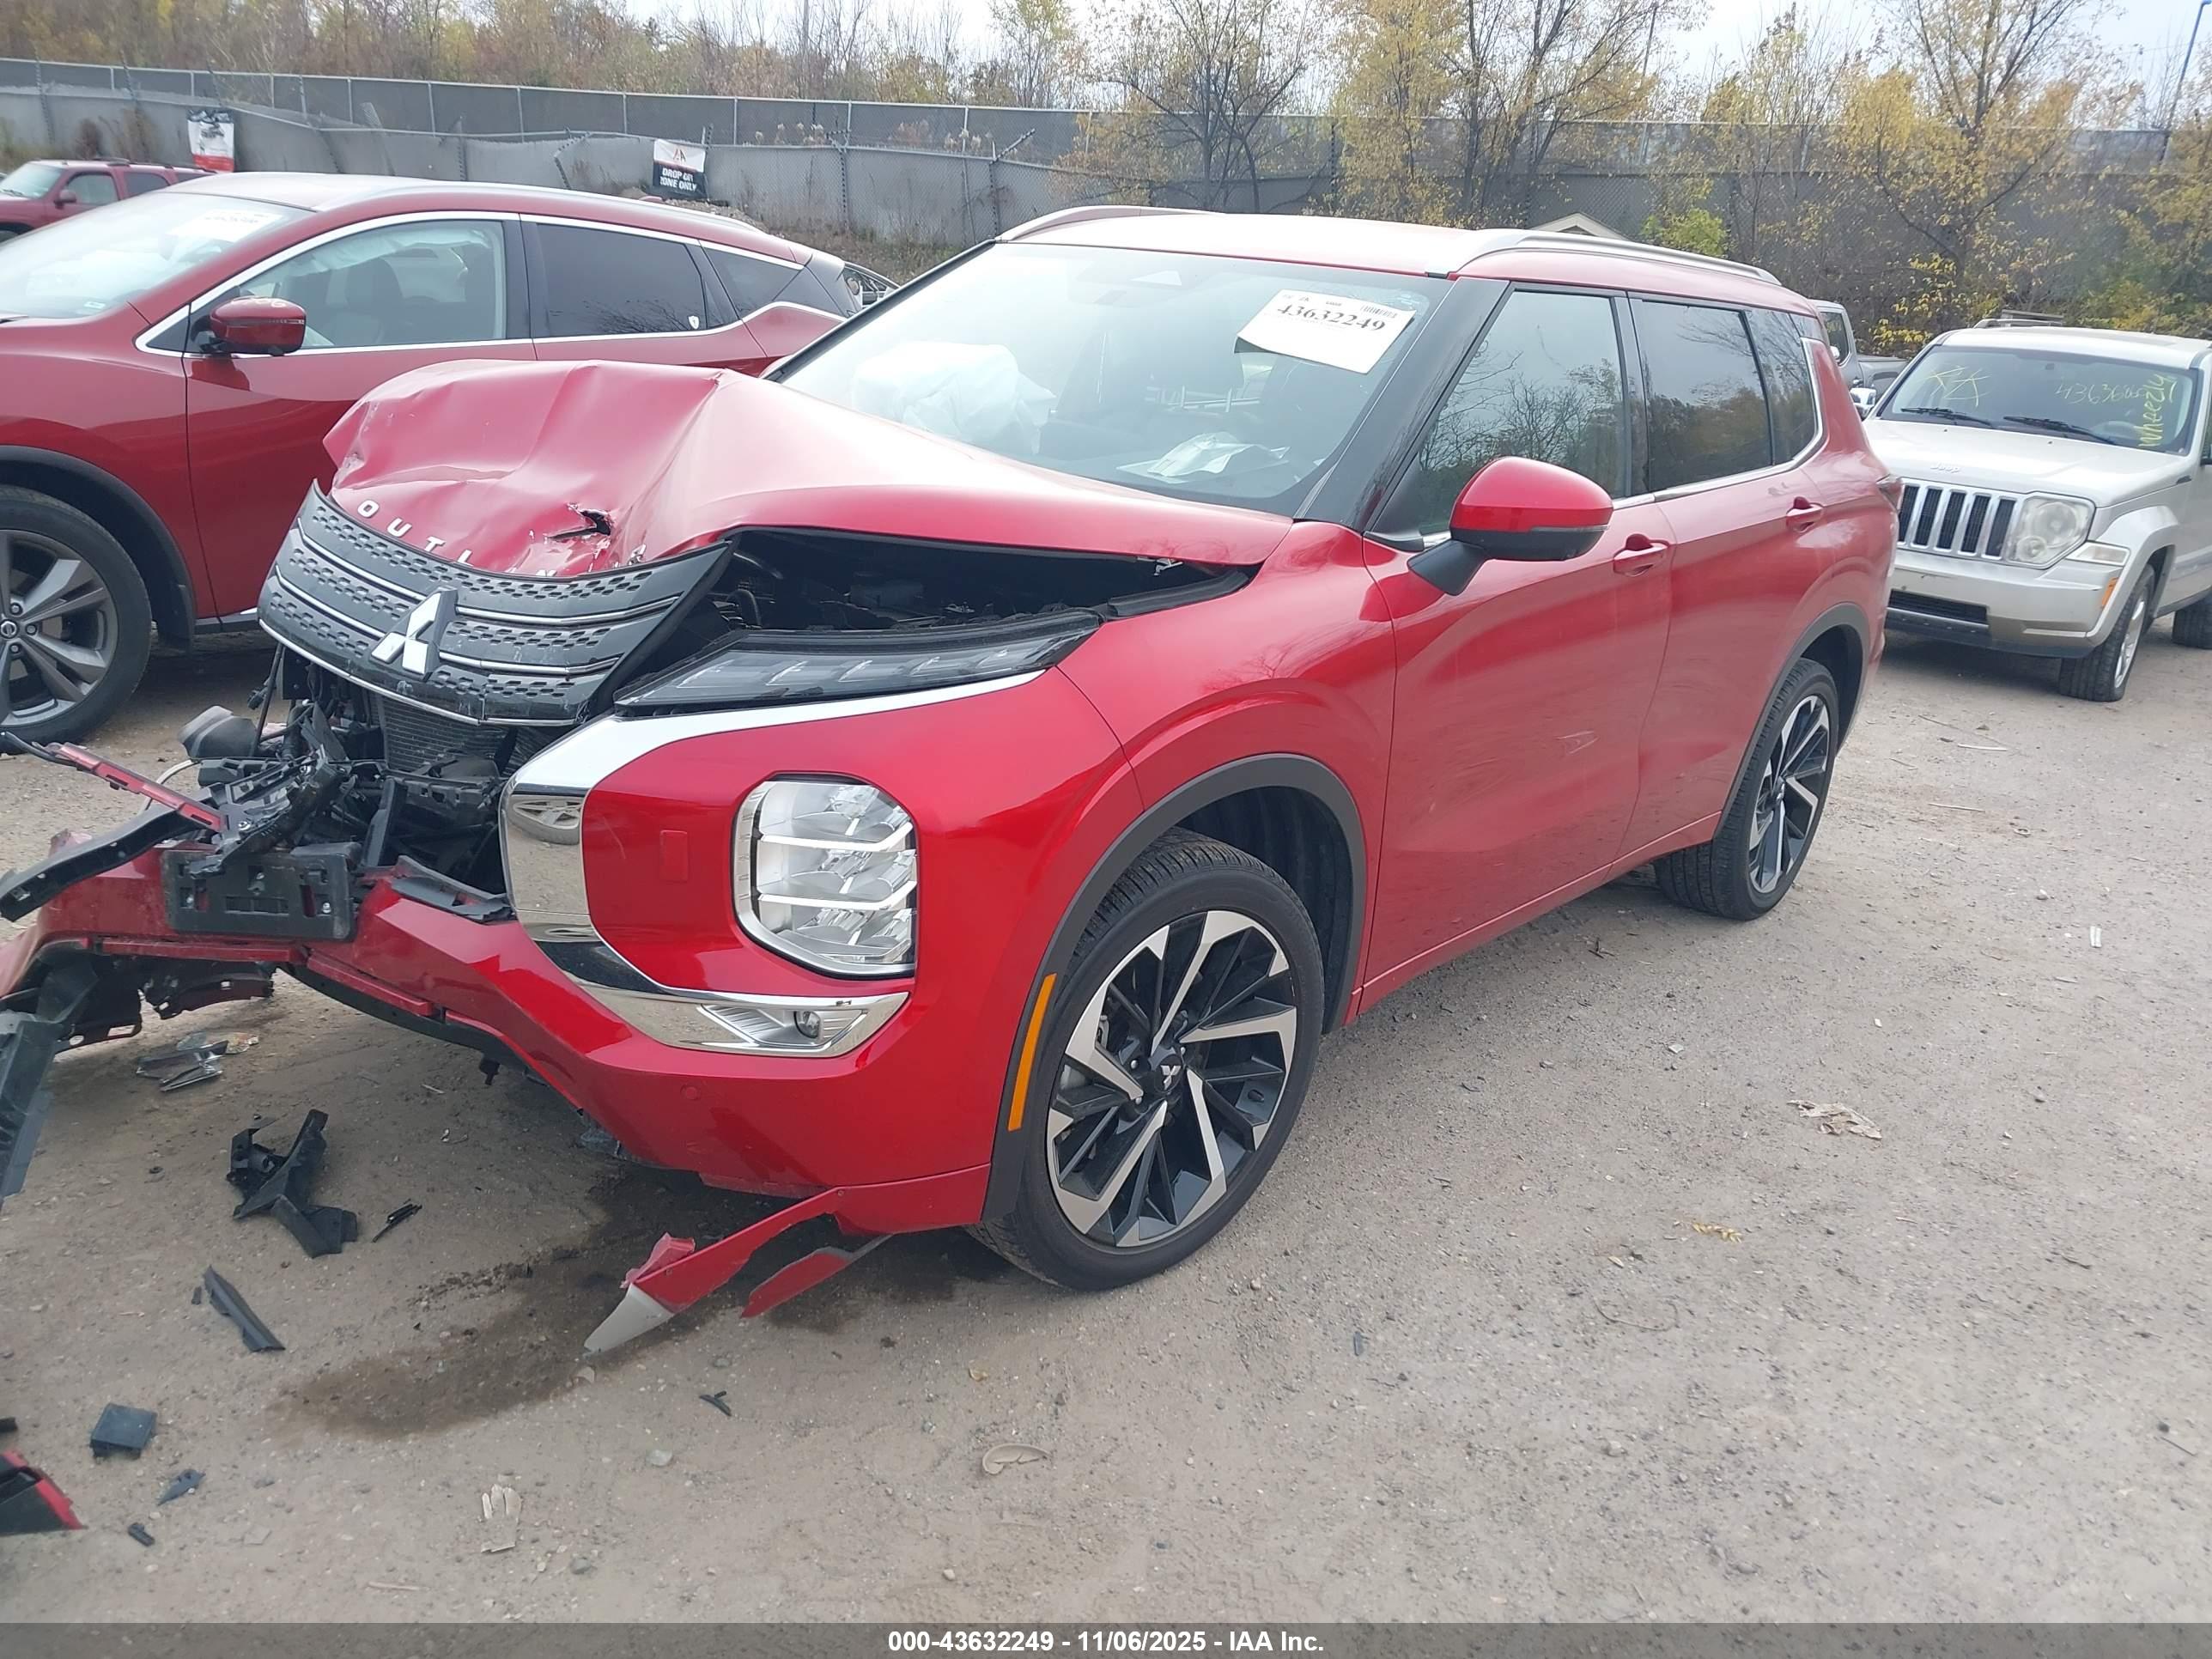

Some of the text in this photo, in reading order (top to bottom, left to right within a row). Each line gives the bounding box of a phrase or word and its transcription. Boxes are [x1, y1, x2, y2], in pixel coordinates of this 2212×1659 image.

[662, 167, 683, 179] DROP
[659, 176, 697, 191] ZONE ONLY
[1278, 304, 1385, 331] 43632249
